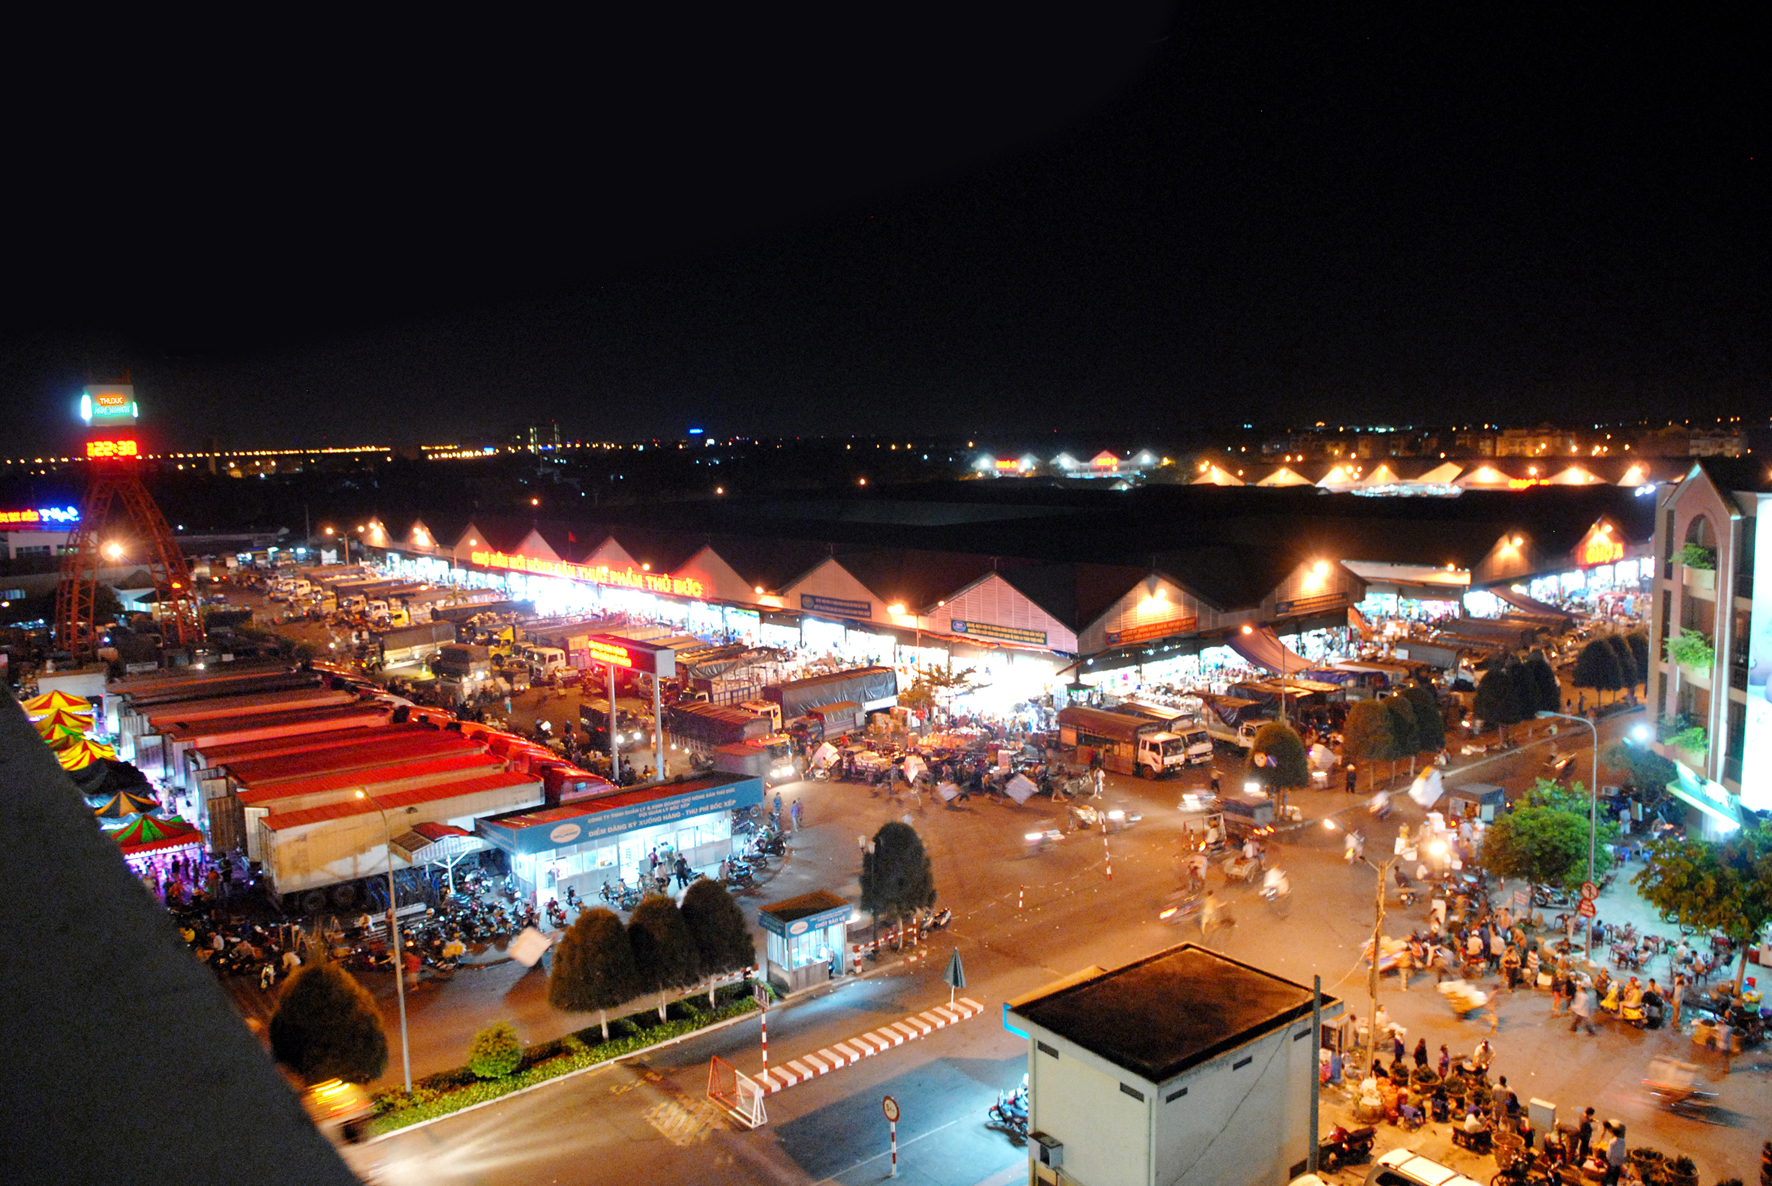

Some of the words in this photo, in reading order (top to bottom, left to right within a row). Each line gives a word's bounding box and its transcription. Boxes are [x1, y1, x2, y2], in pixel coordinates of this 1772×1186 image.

[472, 551, 490, 568] CHỢ
[645, 573, 671, 592] THỦ
[673, 577, 704, 597] ĐỨC
[588, 826, 607, 838] ĐIỂM
[685, 808, 698, 816] THU
